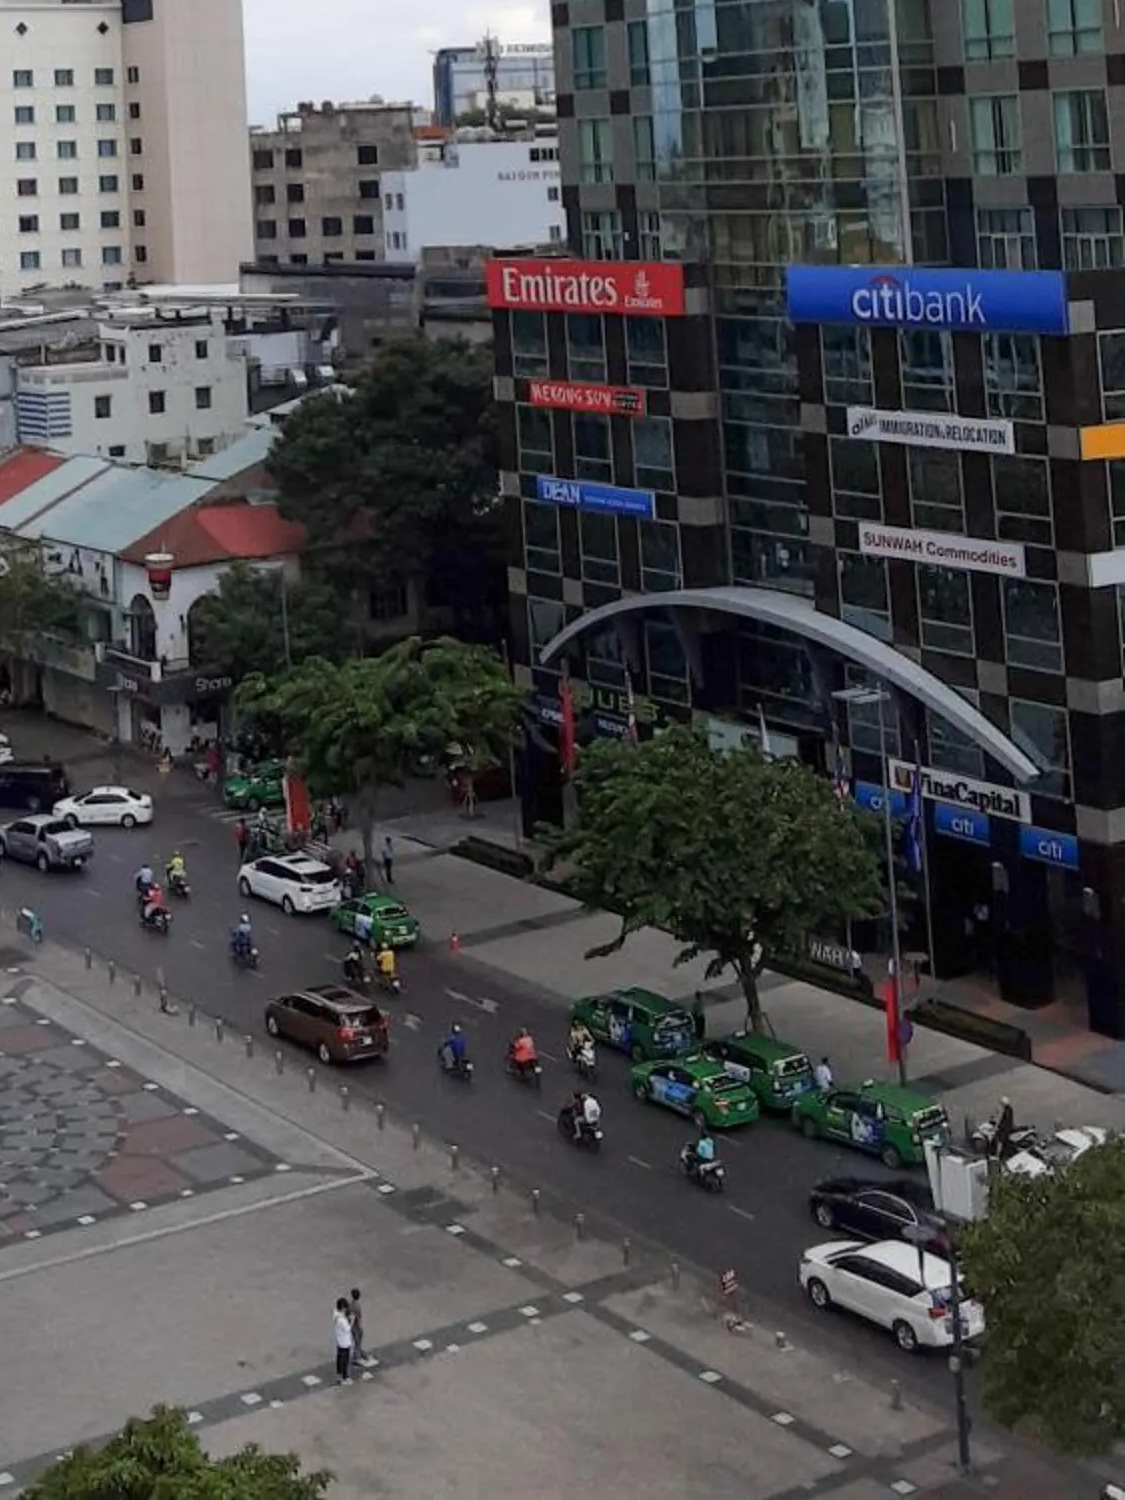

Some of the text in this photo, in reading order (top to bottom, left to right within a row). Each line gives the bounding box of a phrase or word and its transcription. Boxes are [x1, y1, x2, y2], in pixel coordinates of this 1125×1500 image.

[502, 265, 619, 307] Emirates
[852, 280, 987, 324] citibank
[946, 424, 1006, 445] RELOCATION
[542, 481, 580, 505] DEAN
[863, 531, 1017, 568] SUNWAH Commodities
[952, 817, 975, 835] citi
[1038, 841, 1062, 860] citi
